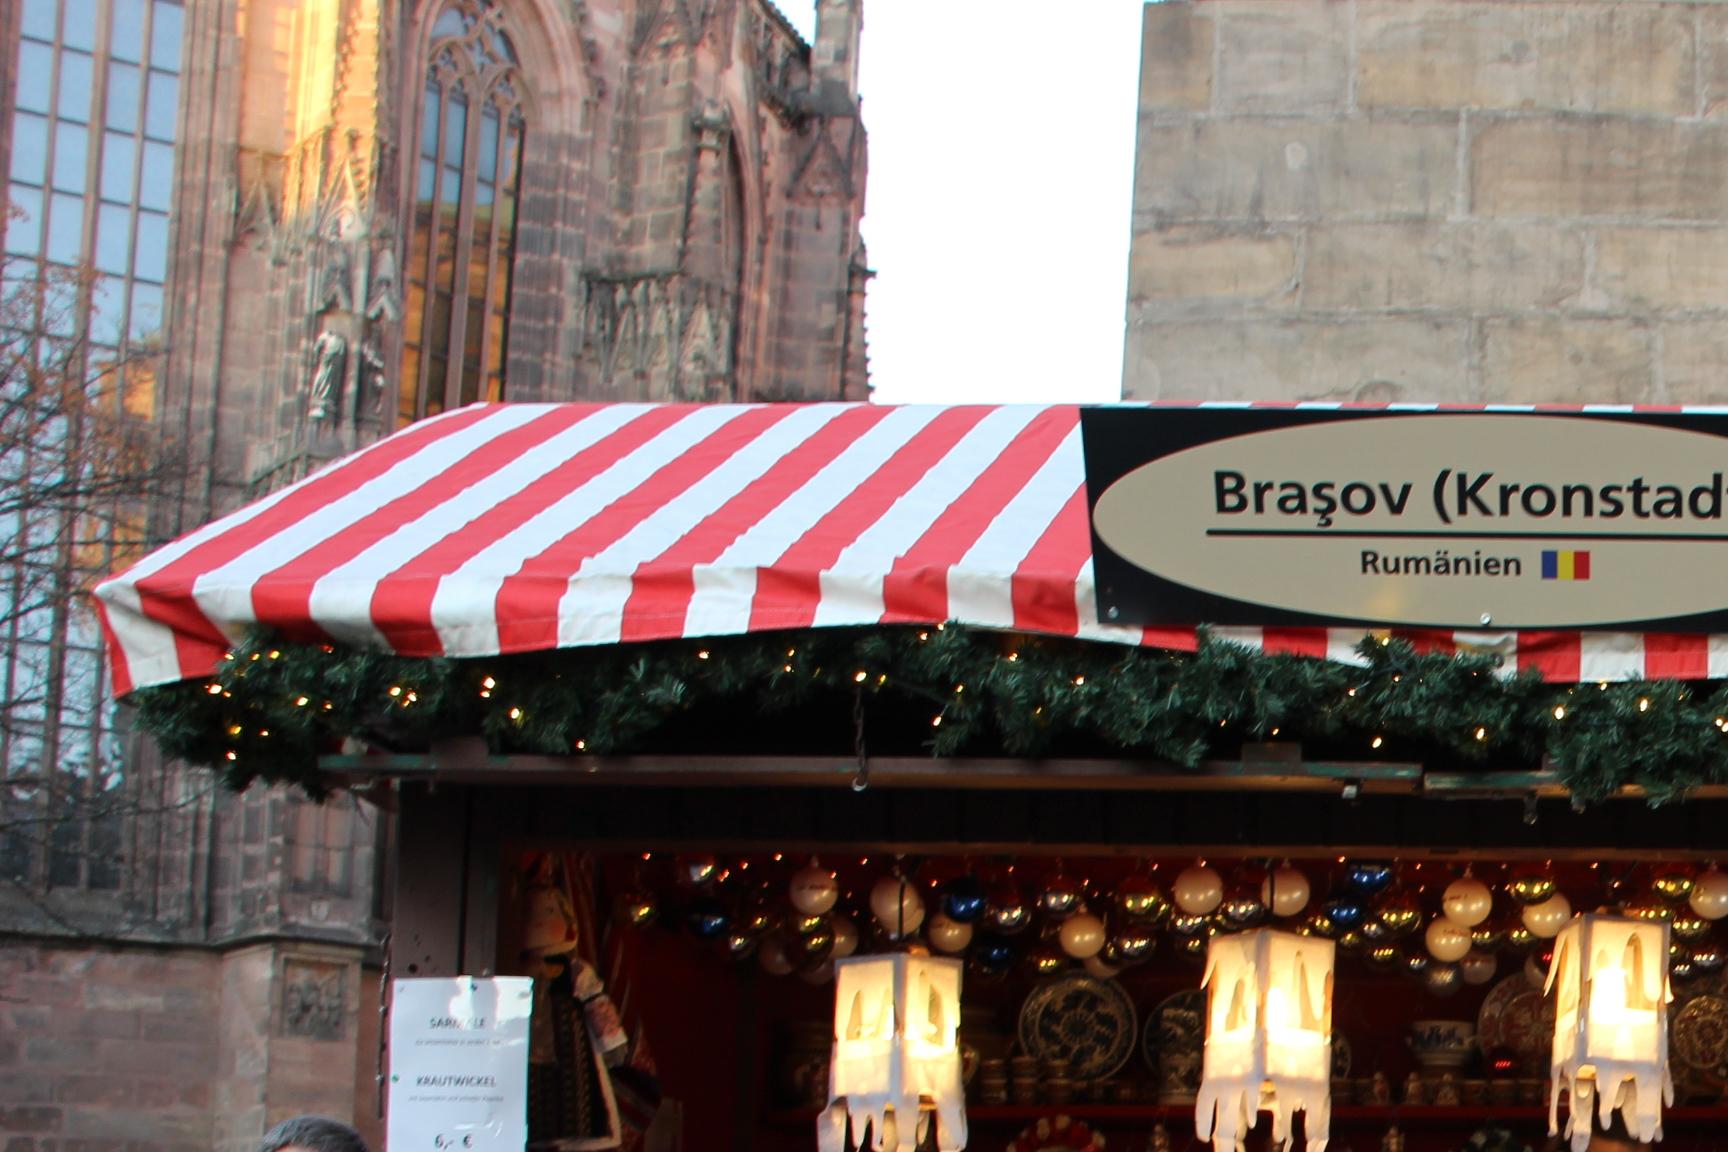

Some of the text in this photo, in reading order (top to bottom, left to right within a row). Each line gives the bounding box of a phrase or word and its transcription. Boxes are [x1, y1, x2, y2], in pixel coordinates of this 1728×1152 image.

[1213, 470, 1413, 528] Braşov
[1360, 549, 1522, 577] Rumänien
[415, 1074, 497, 1088] KRAUTWICKEL
